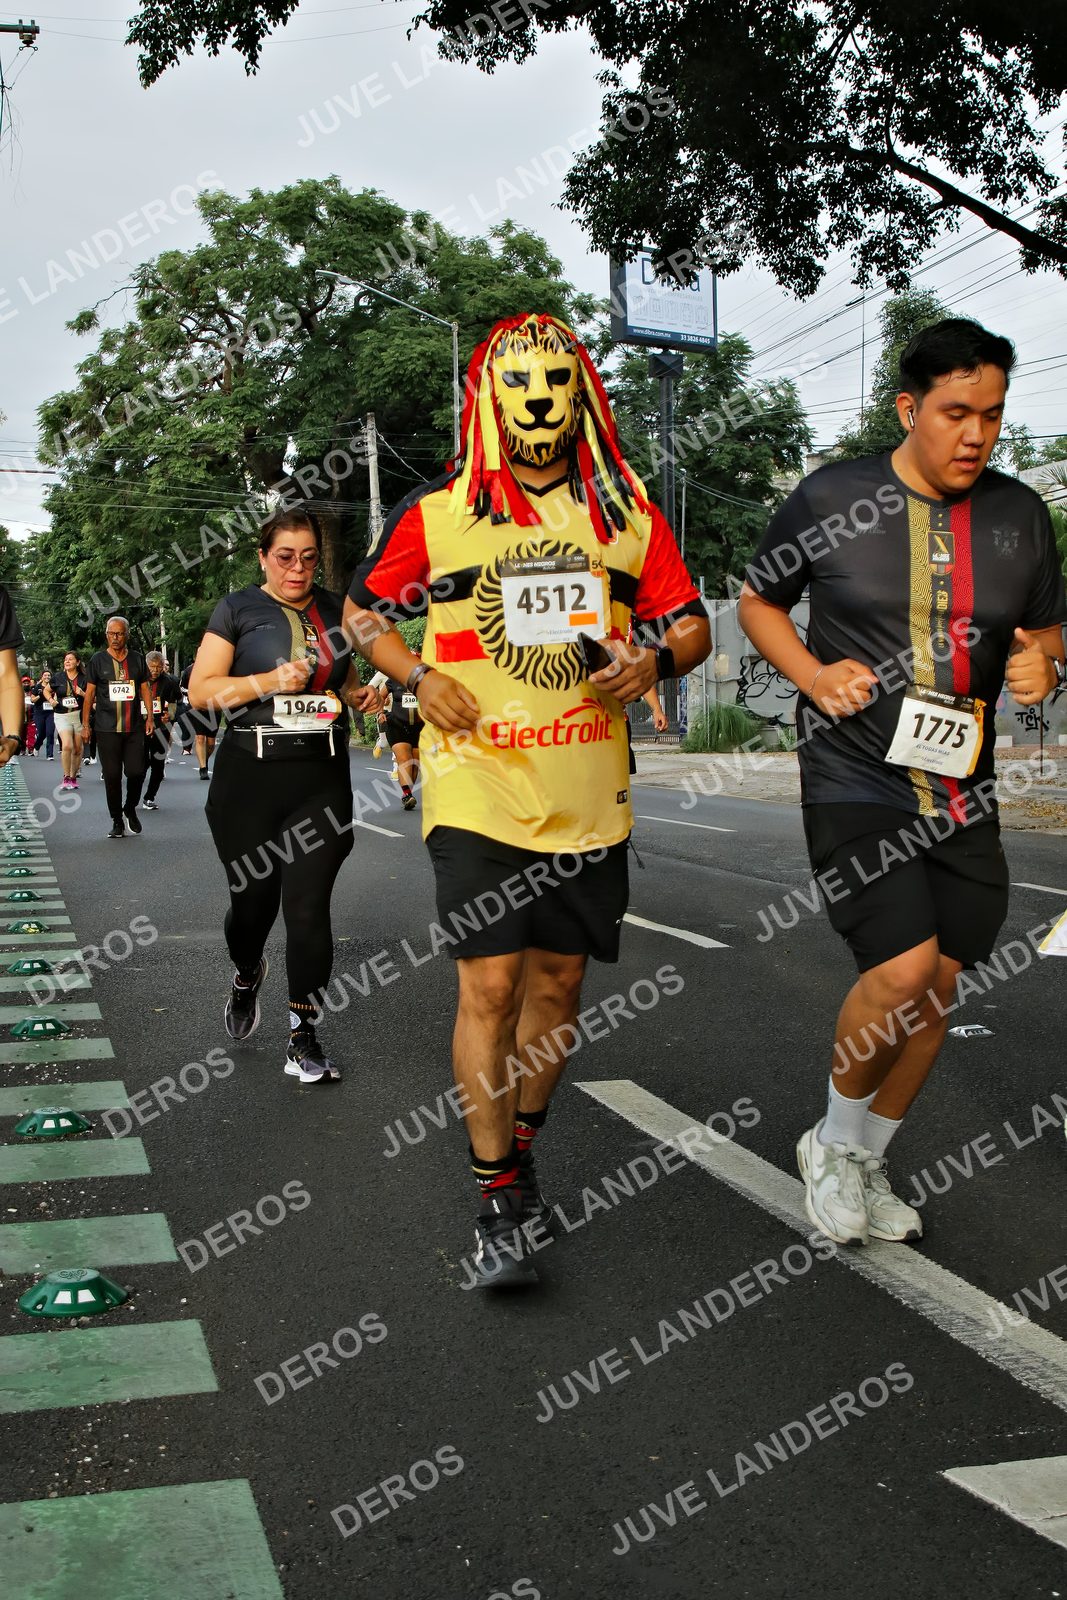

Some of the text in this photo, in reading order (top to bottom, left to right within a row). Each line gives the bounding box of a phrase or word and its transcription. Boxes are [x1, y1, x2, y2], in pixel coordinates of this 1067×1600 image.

[517, 583, 587, 614] 4512
[112, 686, 130, 694] 6742
[284, 700, 328, 715] 1966
[490, 713, 613, 749] Electrolit
[913, 712, 968, 748] 1775
